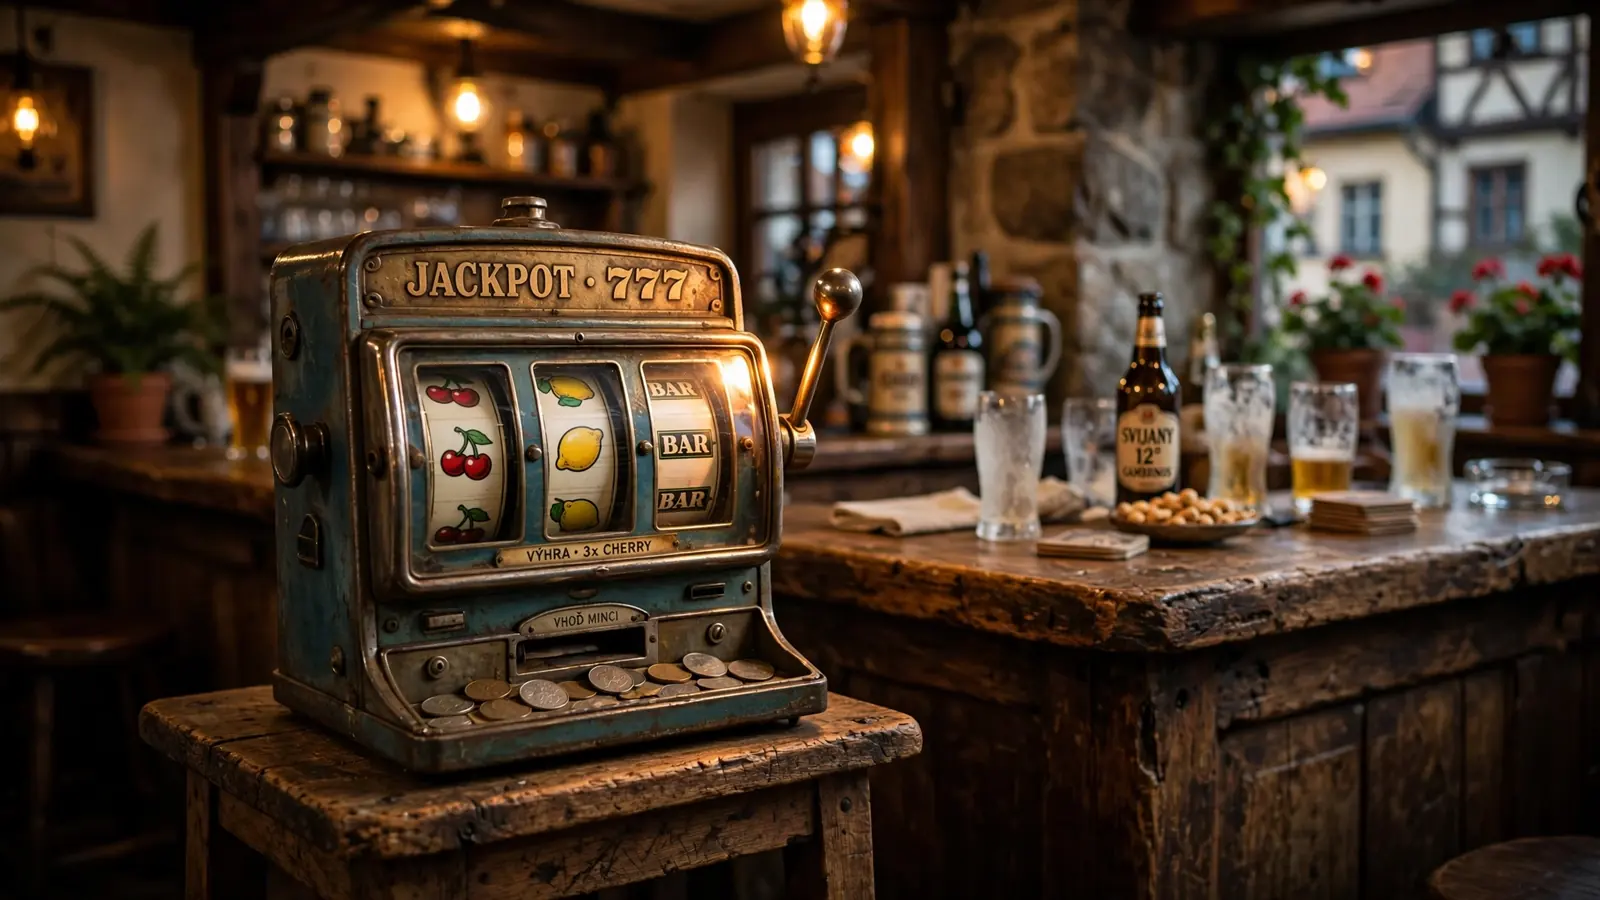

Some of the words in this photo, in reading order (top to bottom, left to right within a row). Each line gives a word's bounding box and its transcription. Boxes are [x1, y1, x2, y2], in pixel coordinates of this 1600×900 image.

[406, 261, 576, 298] JACKPOT
[607, 266, 690, 300] 777
[648, 381, 697, 397] BAR
[662, 433, 710, 455] BAR
[1121, 427, 1174, 445] SVIJANY
[658, 491, 705, 510] BAR
[527, 547, 571, 562] VÝHRA
[583, 545, 599, 557] 3x
[603, 540, 652, 555] CHERRY
[553, 612, 584, 628] VHOĎ
[588, 611, 619, 625] MINCI
